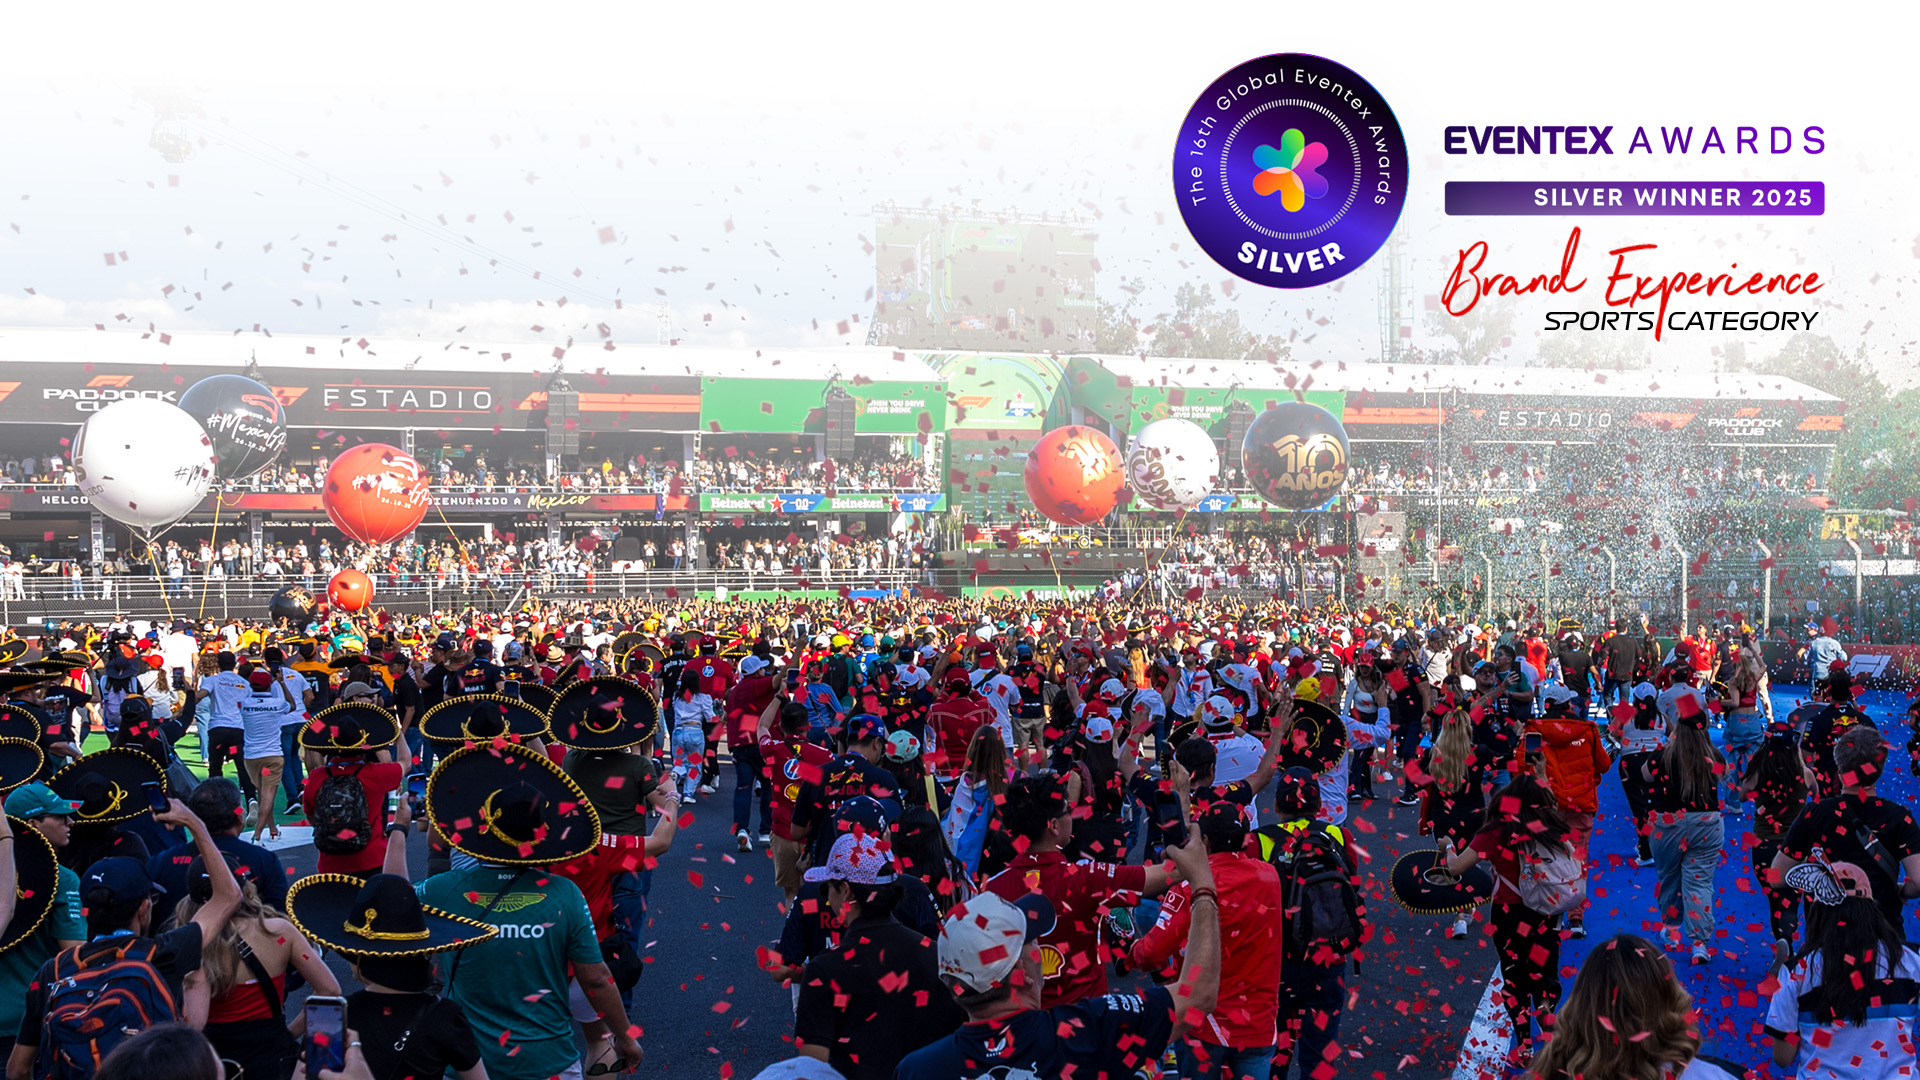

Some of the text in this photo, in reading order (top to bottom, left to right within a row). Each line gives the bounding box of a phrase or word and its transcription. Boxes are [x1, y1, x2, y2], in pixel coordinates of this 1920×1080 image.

[43, 389, 177, 401] PADDOCK
[324, 388, 492, 409] ESTADIO
[1498, 411, 1612, 428] ESTADIO
[1708, 419, 1783, 427] PADDOCK
[1724, 428, 1765, 436] CLUB
[1273, 433, 1346, 473] 10
[514, 497, 521, 505] A
[527, 494, 591, 510] Mexico
[711, 497, 766, 509] Heineken
[831, 497, 884, 509] Heineken
[846, 785, 866, 795] Bull
[819, 912, 849, 929] Re
